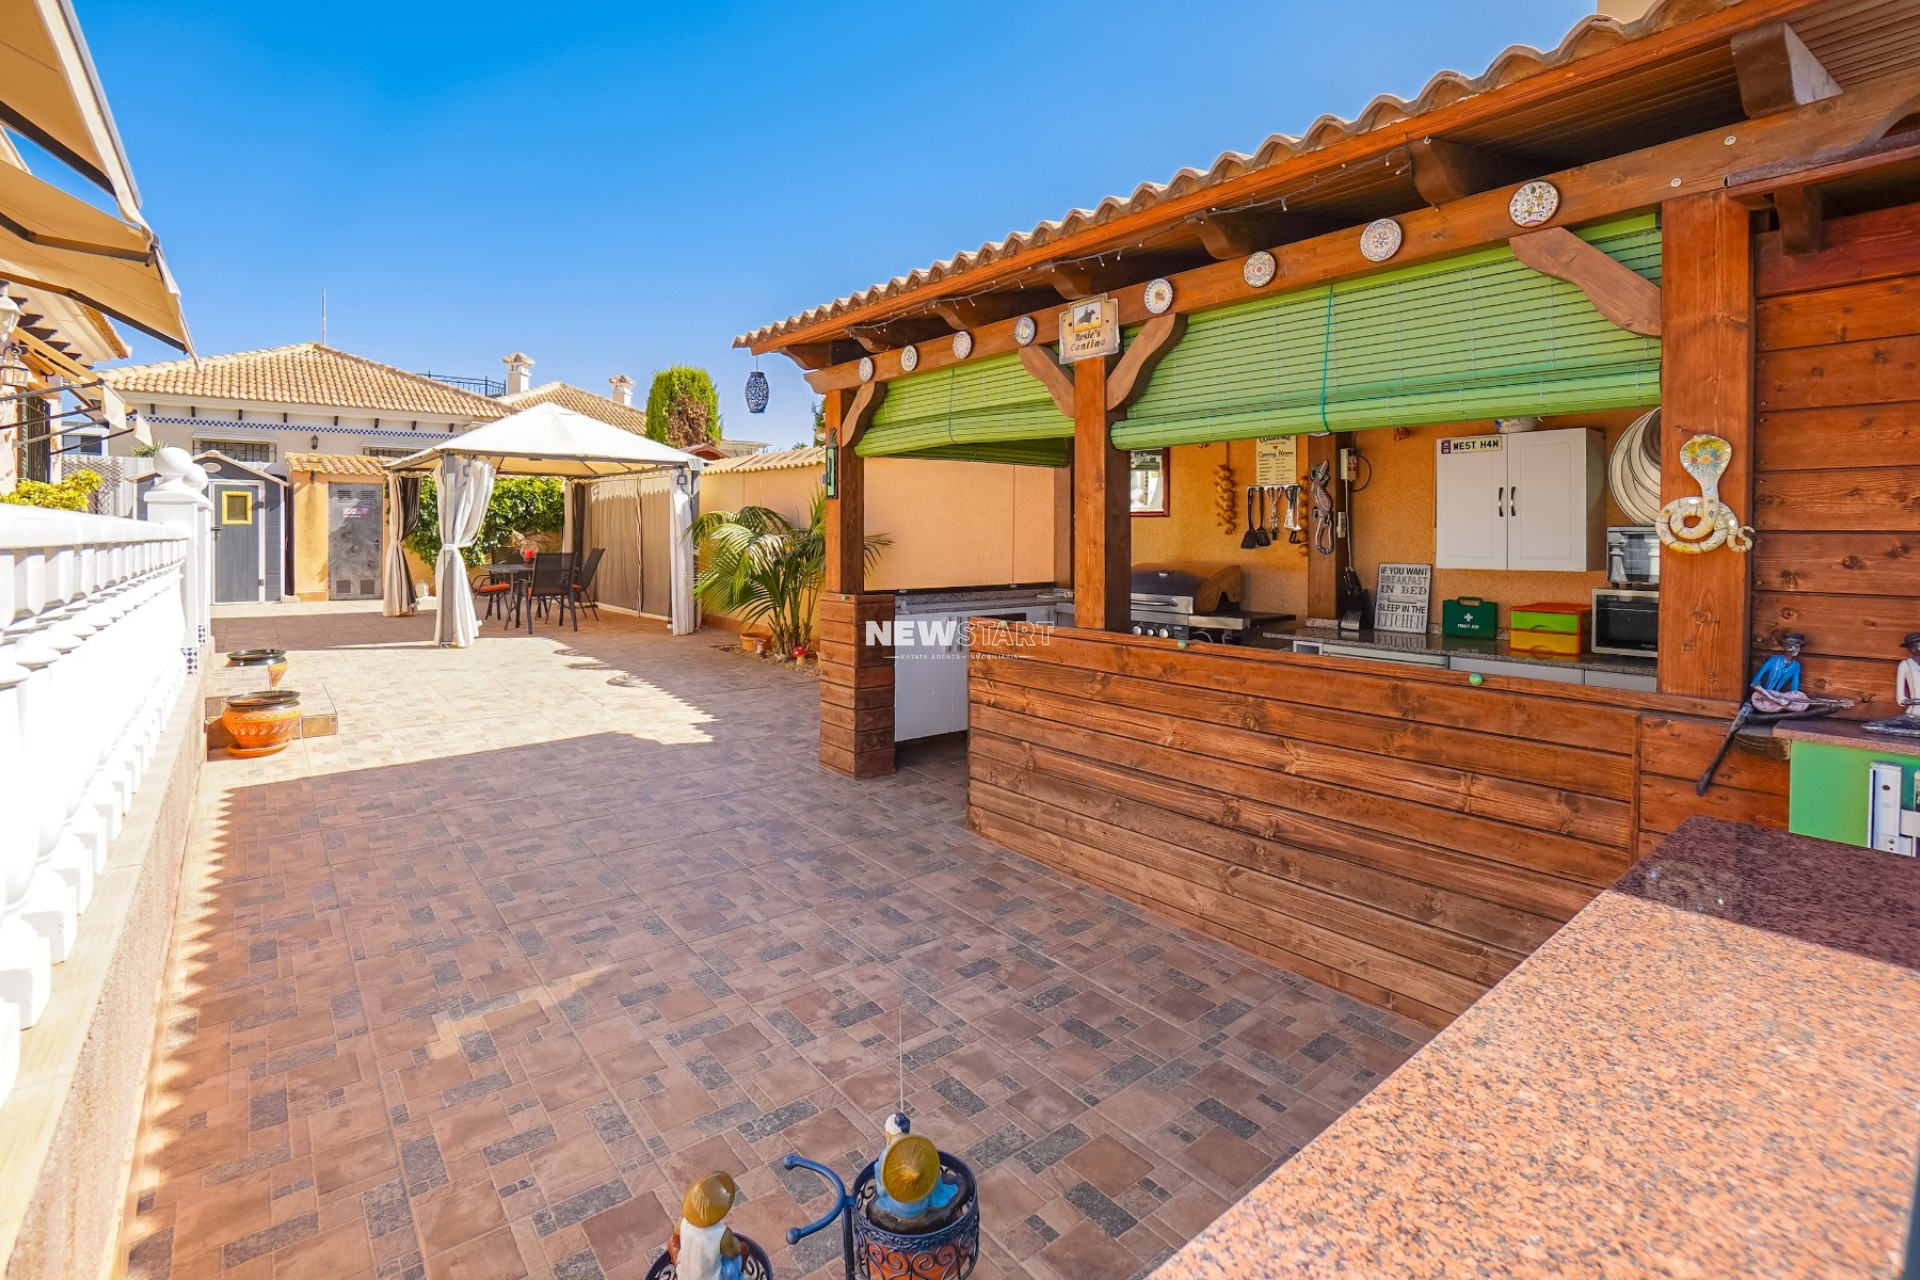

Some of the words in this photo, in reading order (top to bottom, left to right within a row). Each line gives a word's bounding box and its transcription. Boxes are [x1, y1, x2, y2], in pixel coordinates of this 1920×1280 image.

[1071, 338, 1106, 352] Cantina
[1381, 566, 1388, 574] IF
[1390, 566, 1405, 575] YOU
[1406, 567, 1428, 576] WANT
[1380, 575, 1428, 586] BREAKFAST
[1380, 584, 1395, 594] IN
[1401, 585, 1427, 595] BED
[1378, 603, 1400, 612] SLEEP
[1402, 605, 1410, 613] IN
[1411, 605, 1426, 614] THE
[1377, 611, 1425, 629] KITCHEN
